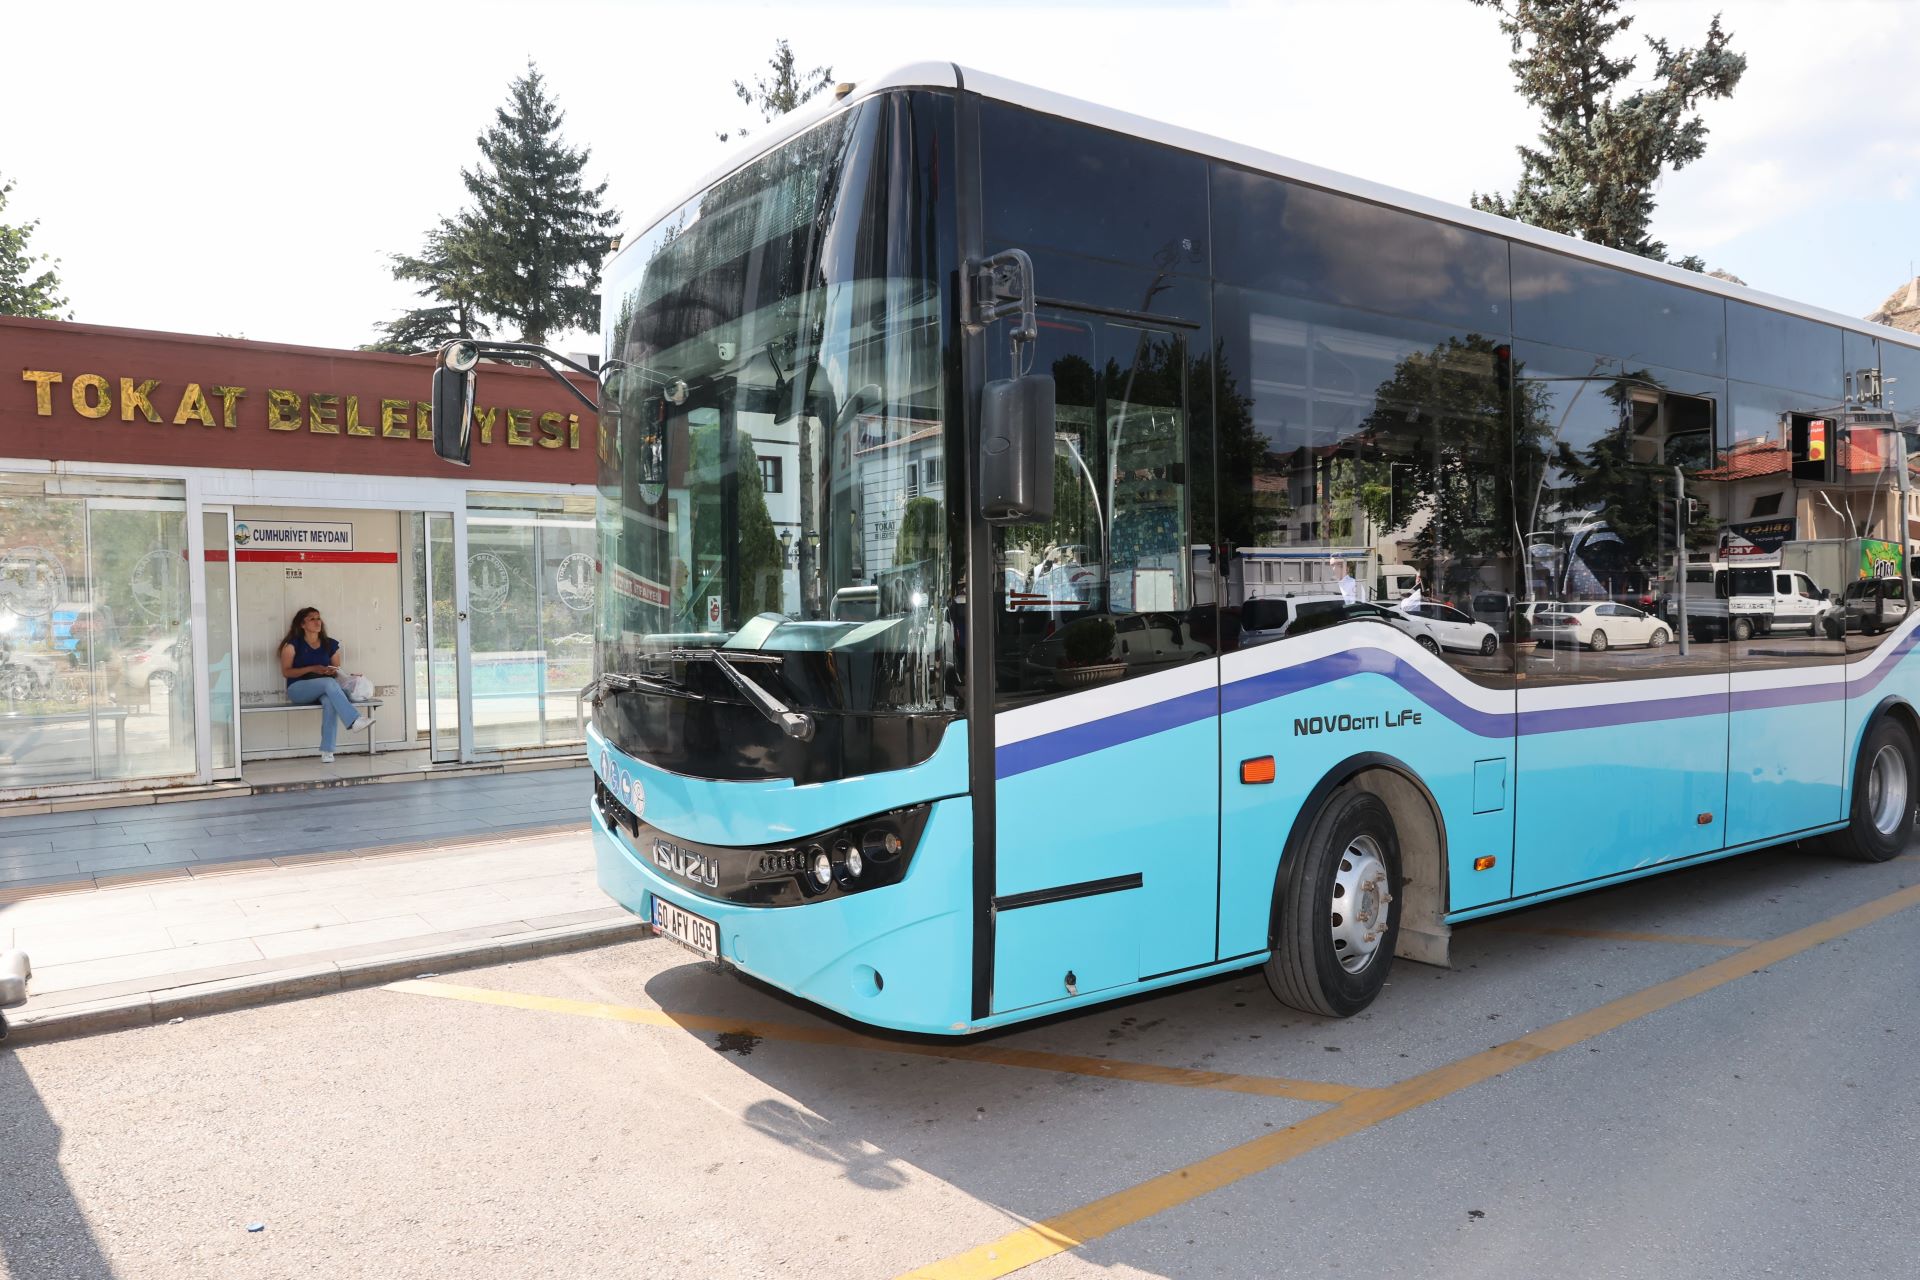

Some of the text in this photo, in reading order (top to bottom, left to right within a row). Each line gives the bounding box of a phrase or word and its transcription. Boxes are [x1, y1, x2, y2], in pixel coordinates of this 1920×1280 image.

[22, 370, 248, 428] TOKAT
[268, 389, 581, 450] BELEDYESİ
[253, 527, 349, 543] CUMHURİYET MEYDANI
[652, 838, 719, 888] ISUZU
[657, 902, 669, 930] 60
[692, 919, 713, 952] 069
